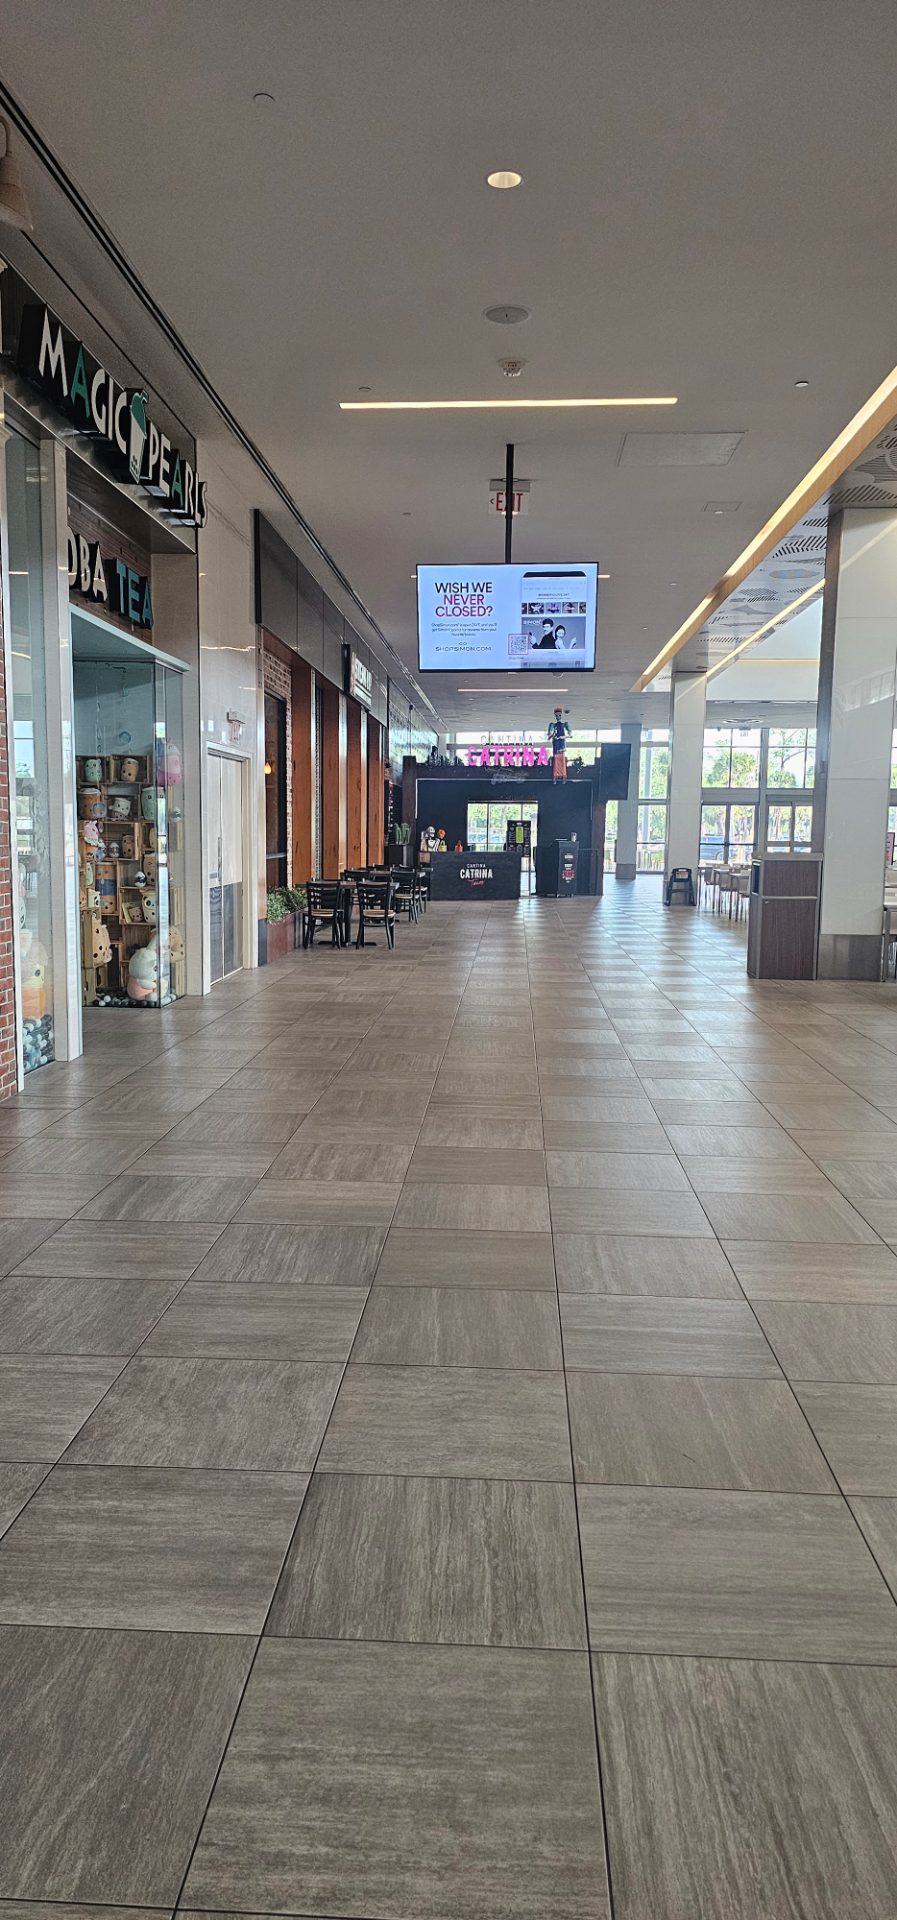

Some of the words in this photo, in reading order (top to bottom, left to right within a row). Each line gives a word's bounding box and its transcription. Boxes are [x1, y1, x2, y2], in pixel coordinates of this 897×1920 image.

[38, 307, 128, 455] MAGIC
[147, 421, 208, 529] PEARLS
[67, 525, 108, 602] OBA
[116, 558, 153, 629] TEA
[434, 582, 469, 594] WISH
[471, 582, 493, 593] WE
[443, 594, 485, 606] NEVER
[435, 606, 493, 617] CLOSED?
[467, 744, 549, 767] CATRINA
[459, 868, 493, 879] CATRINA
